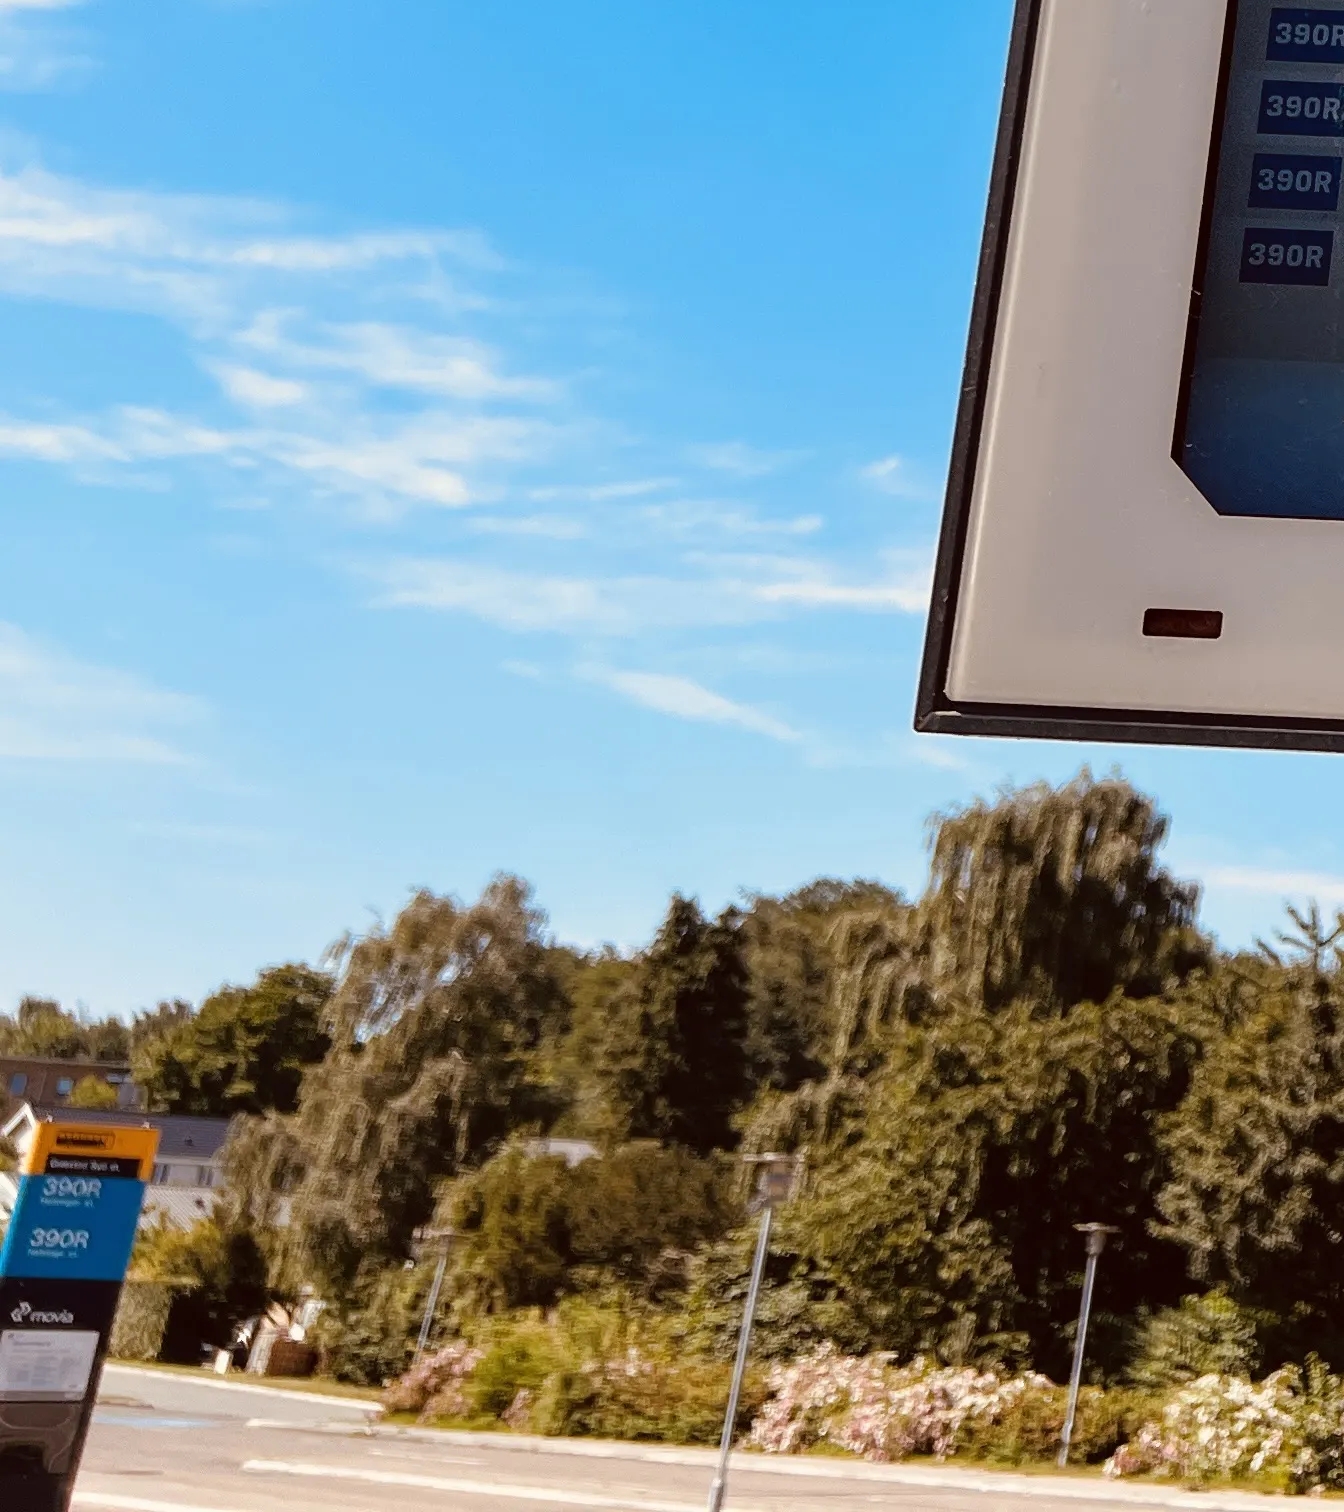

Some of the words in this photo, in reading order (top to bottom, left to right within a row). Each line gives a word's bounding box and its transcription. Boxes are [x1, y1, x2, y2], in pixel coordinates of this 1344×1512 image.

[1266, 96, 1341, 121] 390R
[1257, 168, 1332, 193] 390R
[1248, 243, 1324, 268] 390R
[43, 1175, 102, 1199] 390R
[30, 1227, 90, 1249] 390R
